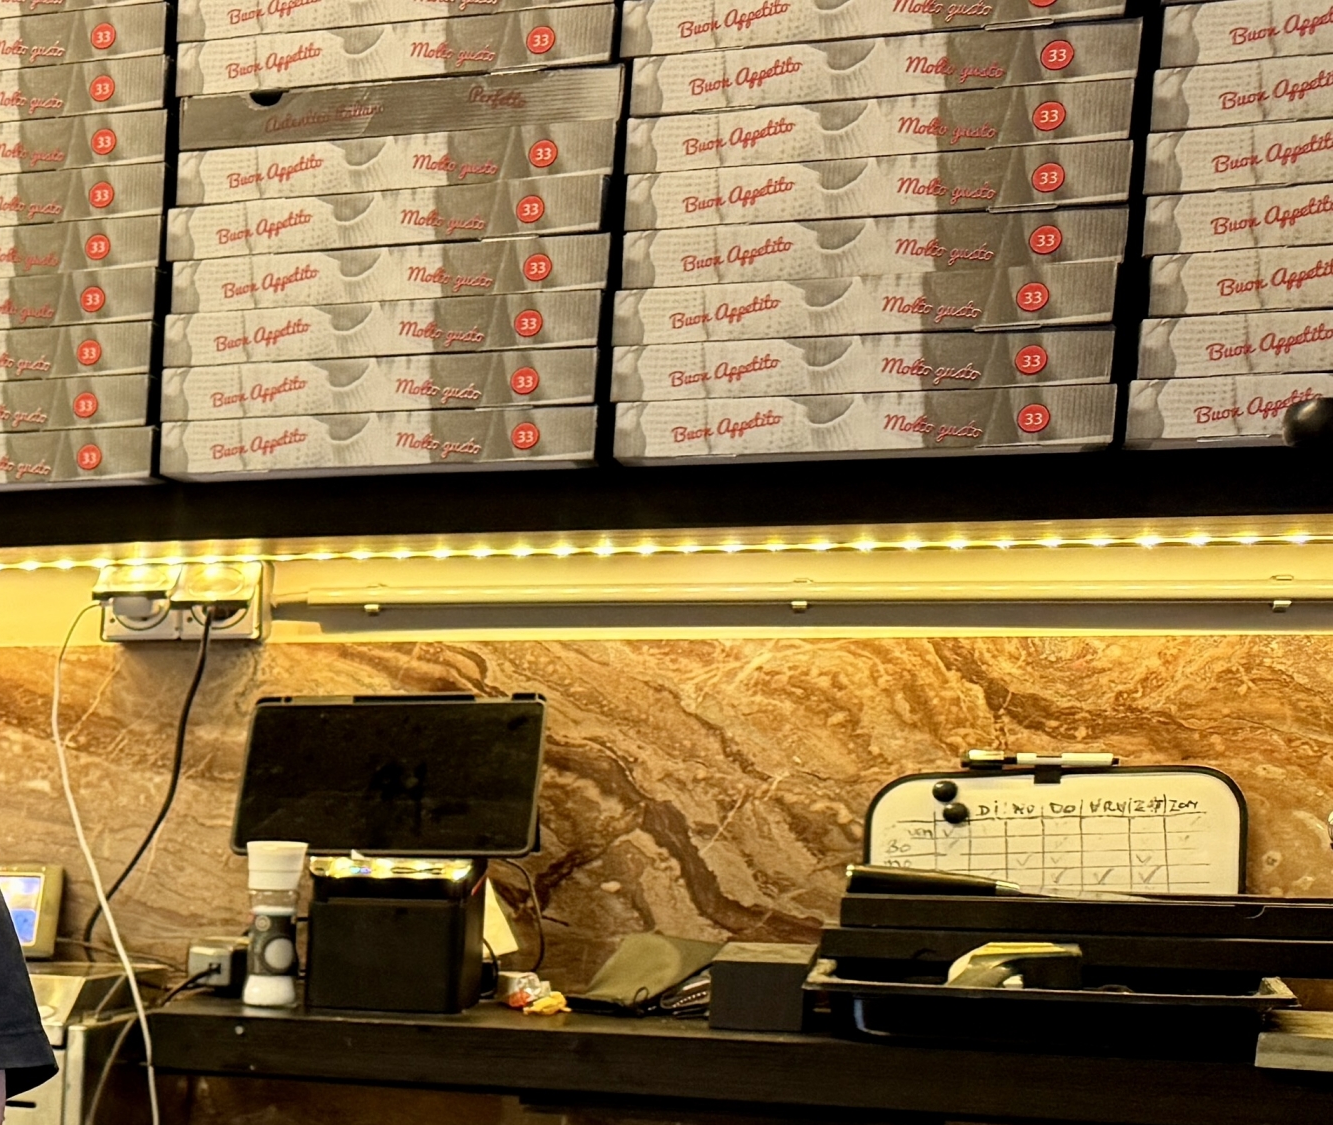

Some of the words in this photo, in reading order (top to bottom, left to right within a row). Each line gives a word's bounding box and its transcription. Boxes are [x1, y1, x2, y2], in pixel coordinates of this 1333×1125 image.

[533, 33, 550, 47] 33
[226, 62, 264, 79] Buon
[265, 44, 322, 72] Appetito
[411, 42, 454, 60] Molto
[456, 49, 497, 68] gusto
[1048, 47, 1067, 63] 33
[688, 77, 733, 97] Buon
[735, 58, 803, 89] Appetito
[906, 57, 957, 76] Molto
[959, 61, 1007, 84] gusto
[95, 82, 110, 96] 33
[468, 85, 526, 109] Perfetto
[28, 96, 64, 114] gusto
[1040, 109, 1059, 124] 33
[682, 137, 727, 156] Buon
[729, 119, 795, 149] Appetito
[898, 117, 950, 137] Molto
[950, 122, 999, 146] gusto
[535, 147, 552, 161] 33
[226, 172, 266, 189] Buon
[267, 155, 324, 183] Appetito
[413, 154, 457, 173] Molto
[458, 159, 501, 180] gusto
[94, 188, 109, 202] 33
[28, 202, 64, 219] gusto
[1211, 216, 1261, 236] Buon
[1036, 233, 1056, 248] 33
[681, 255, 724, 273] Buon
[727, 237, 793, 266] Appetito
[896, 239, 946, 259] Molto
[949, 245, 995, 267] gusto
[529, 261, 546, 275] 33
[221, 282, 260, 299] Buon
[261, 266, 319, 292] Appetito
[408, 267, 453, 285] Molto
[453, 273, 494, 293] gusto
[86, 293, 101, 307] 33
[19, 303, 56, 323] gusto
[1206, 342, 1255, 362] Buon
[671, 426, 715, 443] Buon
[717, 411, 783, 438] Appetito
[1024, 411, 1044, 426] 33
[517, 430, 534, 443] 33
[884, 415, 934, 434] Molto
[937, 422, 982, 443] gusto
[211, 444, 249, 460] Buon
[250, 430, 307, 455] Appetito
[396, 433, 439, 450] Molto
[441, 441, 481, 460] gusto
[82, 450, 97, 464] 33
[16, 464, 51, 480] gusto
